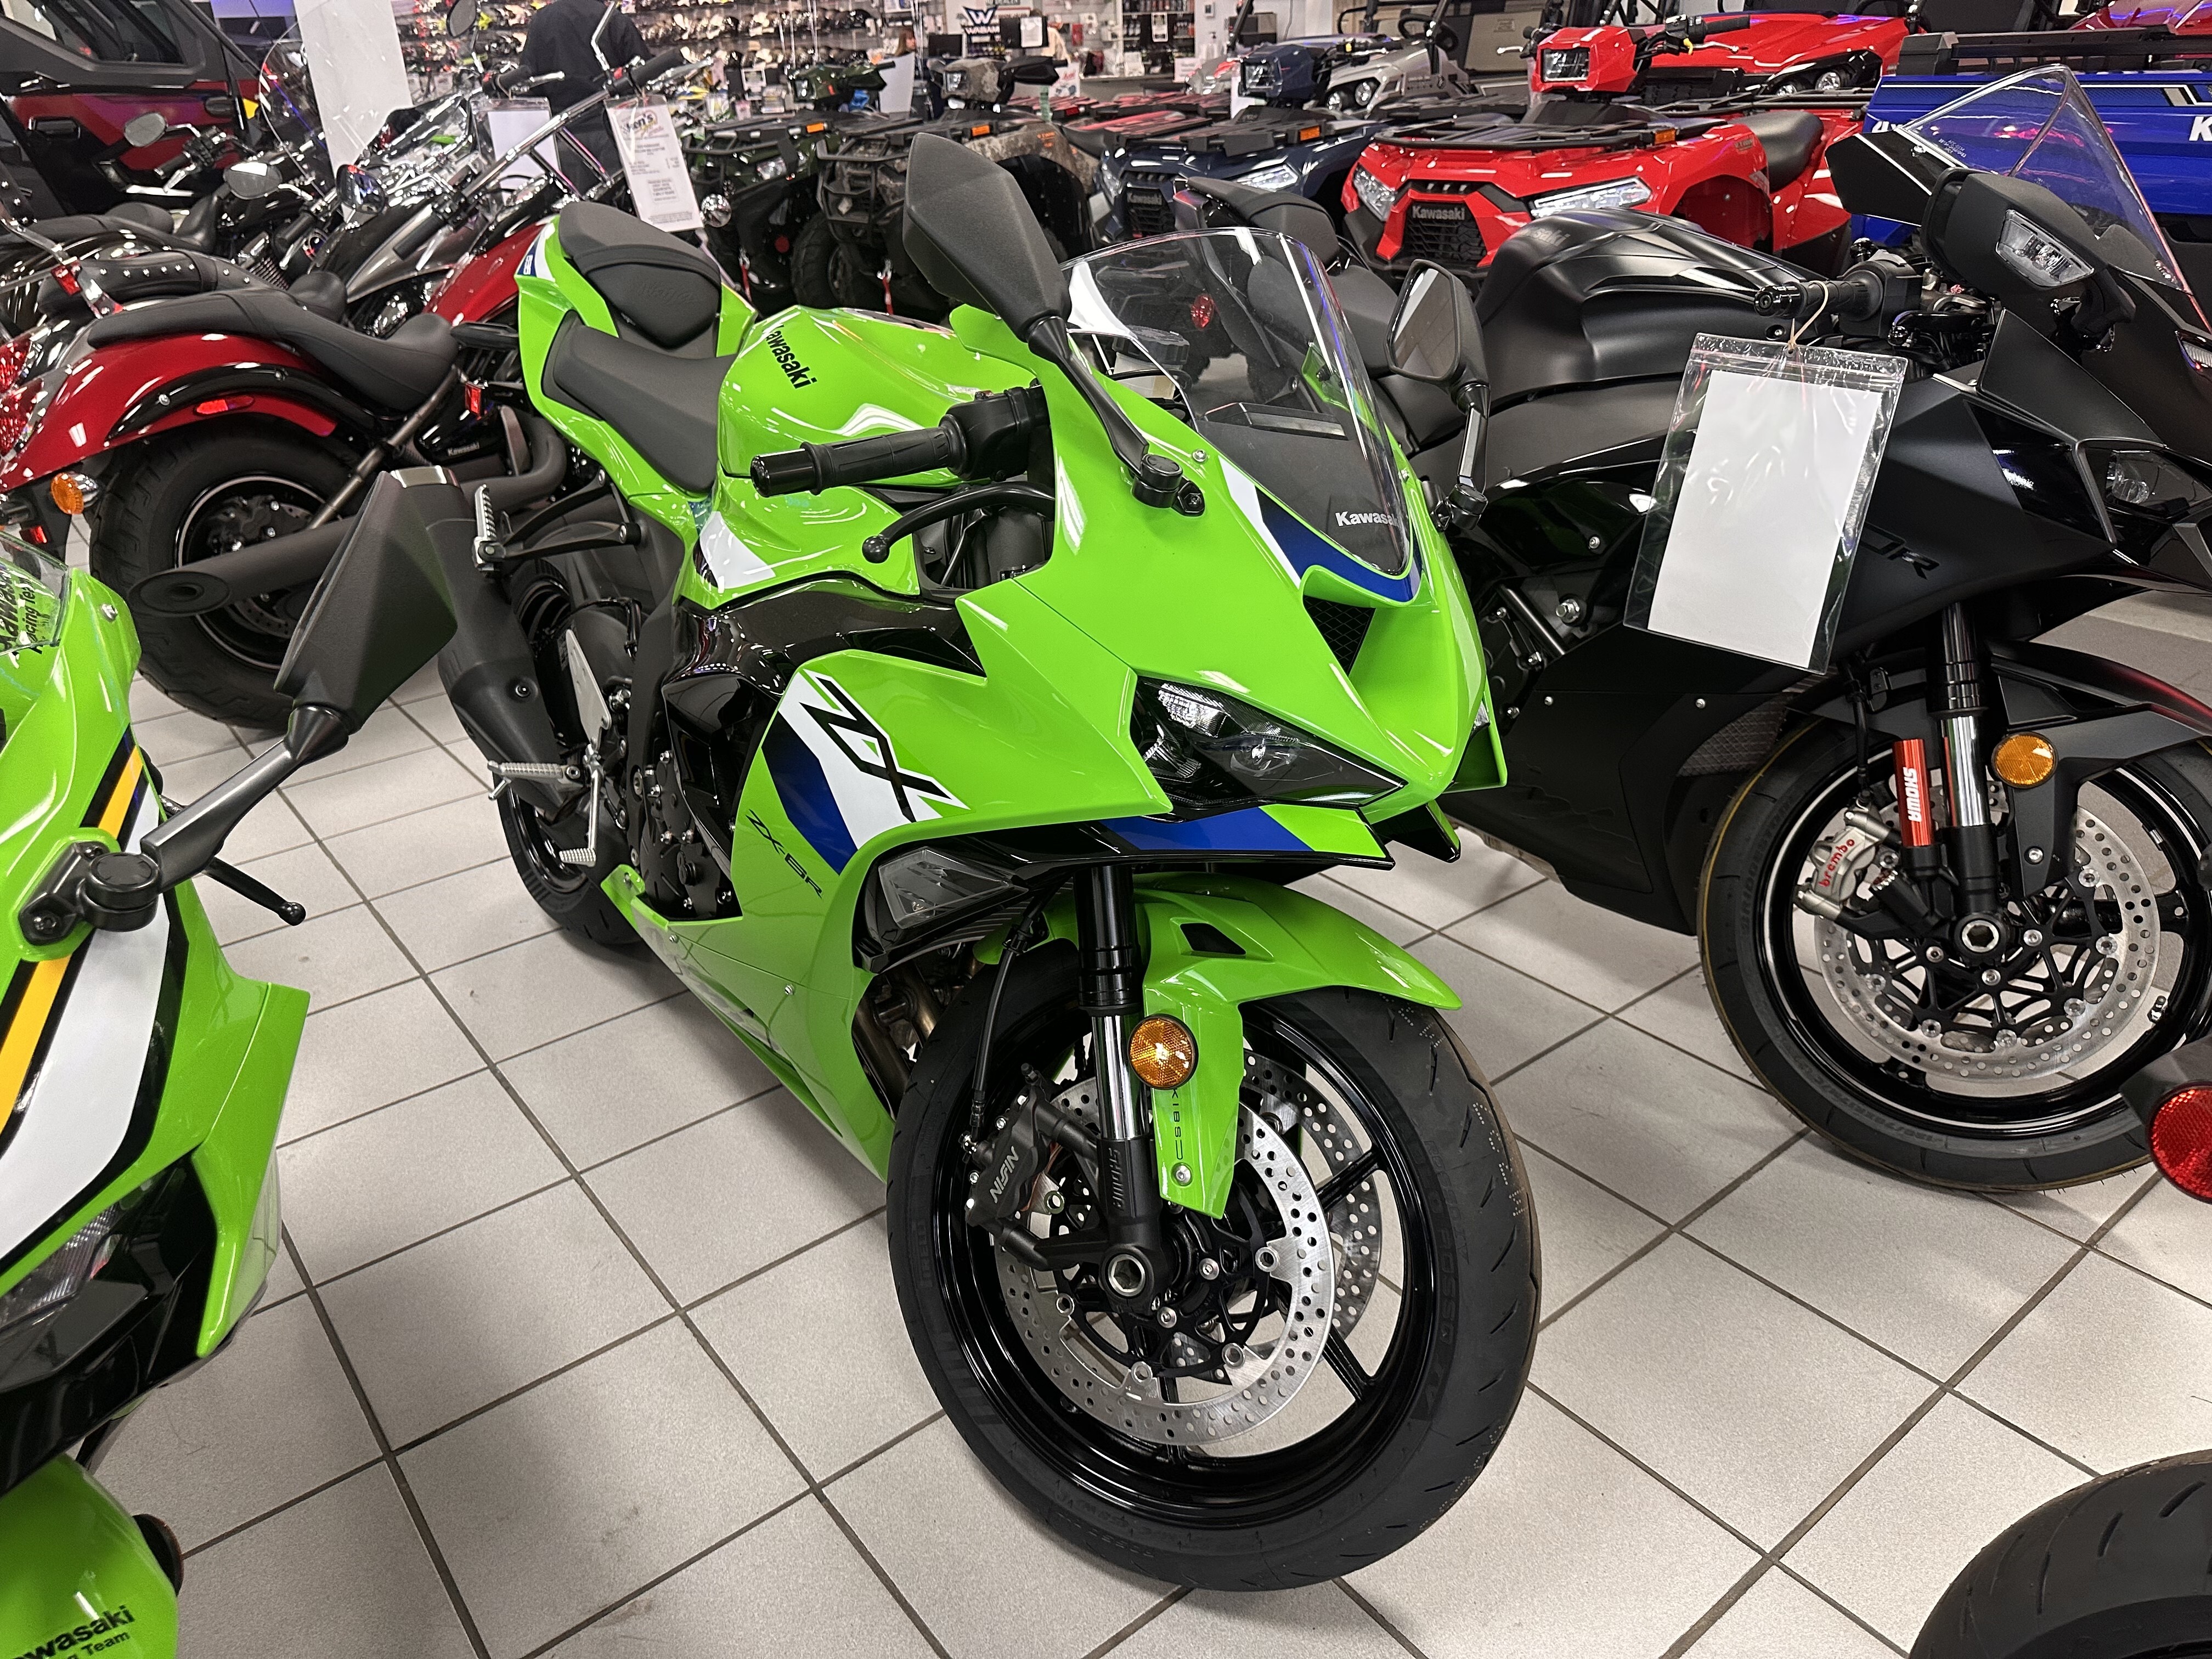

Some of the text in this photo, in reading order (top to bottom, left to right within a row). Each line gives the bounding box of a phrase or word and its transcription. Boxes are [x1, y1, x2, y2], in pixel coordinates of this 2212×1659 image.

[1412, 205, 1465, 221] Kawasaki
[765, 324, 817, 389] awasaki
[447, 441, 480, 456] Kawasaki
[799, 674, 953, 823] ZX
[1902, 766, 1922, 822] SHOWA
[746, 809, 823, 899] ZX-6R
[1818, 838, 1855, 887] brembo
[81, 1632, 131, 1656] Team
